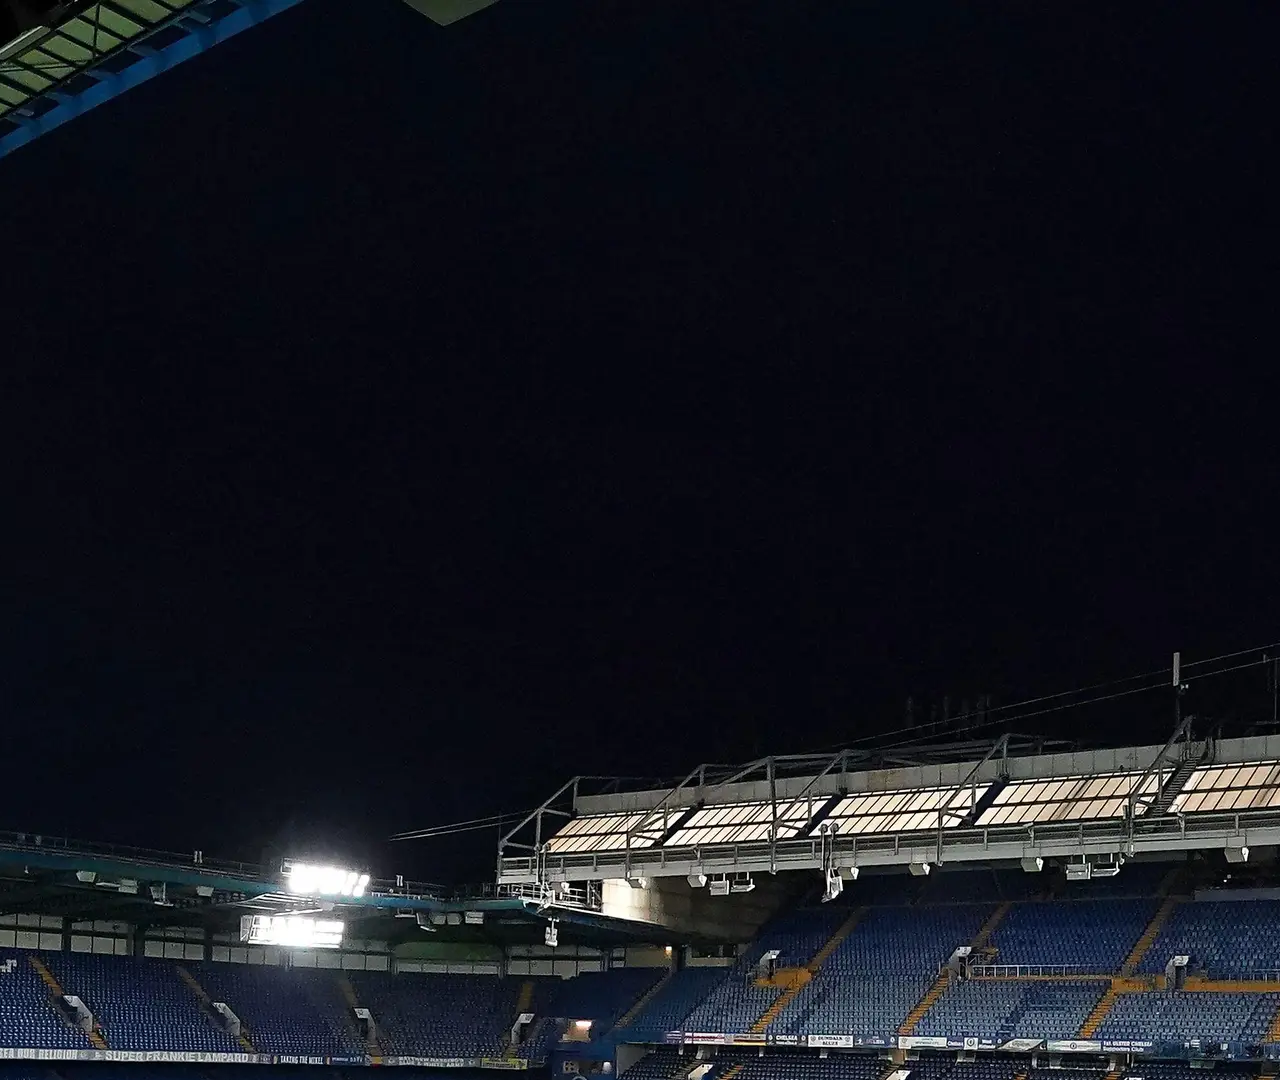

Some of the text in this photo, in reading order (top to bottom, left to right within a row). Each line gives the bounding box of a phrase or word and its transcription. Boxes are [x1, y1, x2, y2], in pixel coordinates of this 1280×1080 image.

[18, 1048, 36, 1059] OUR
[41, 1049, 77, 1060] RELIGION
[105, 1051, 144, 1061] SUPER
[146, 1052, 198, 1062] FRANKIE
[200, 1053, 249, 1062] LAMPARD
